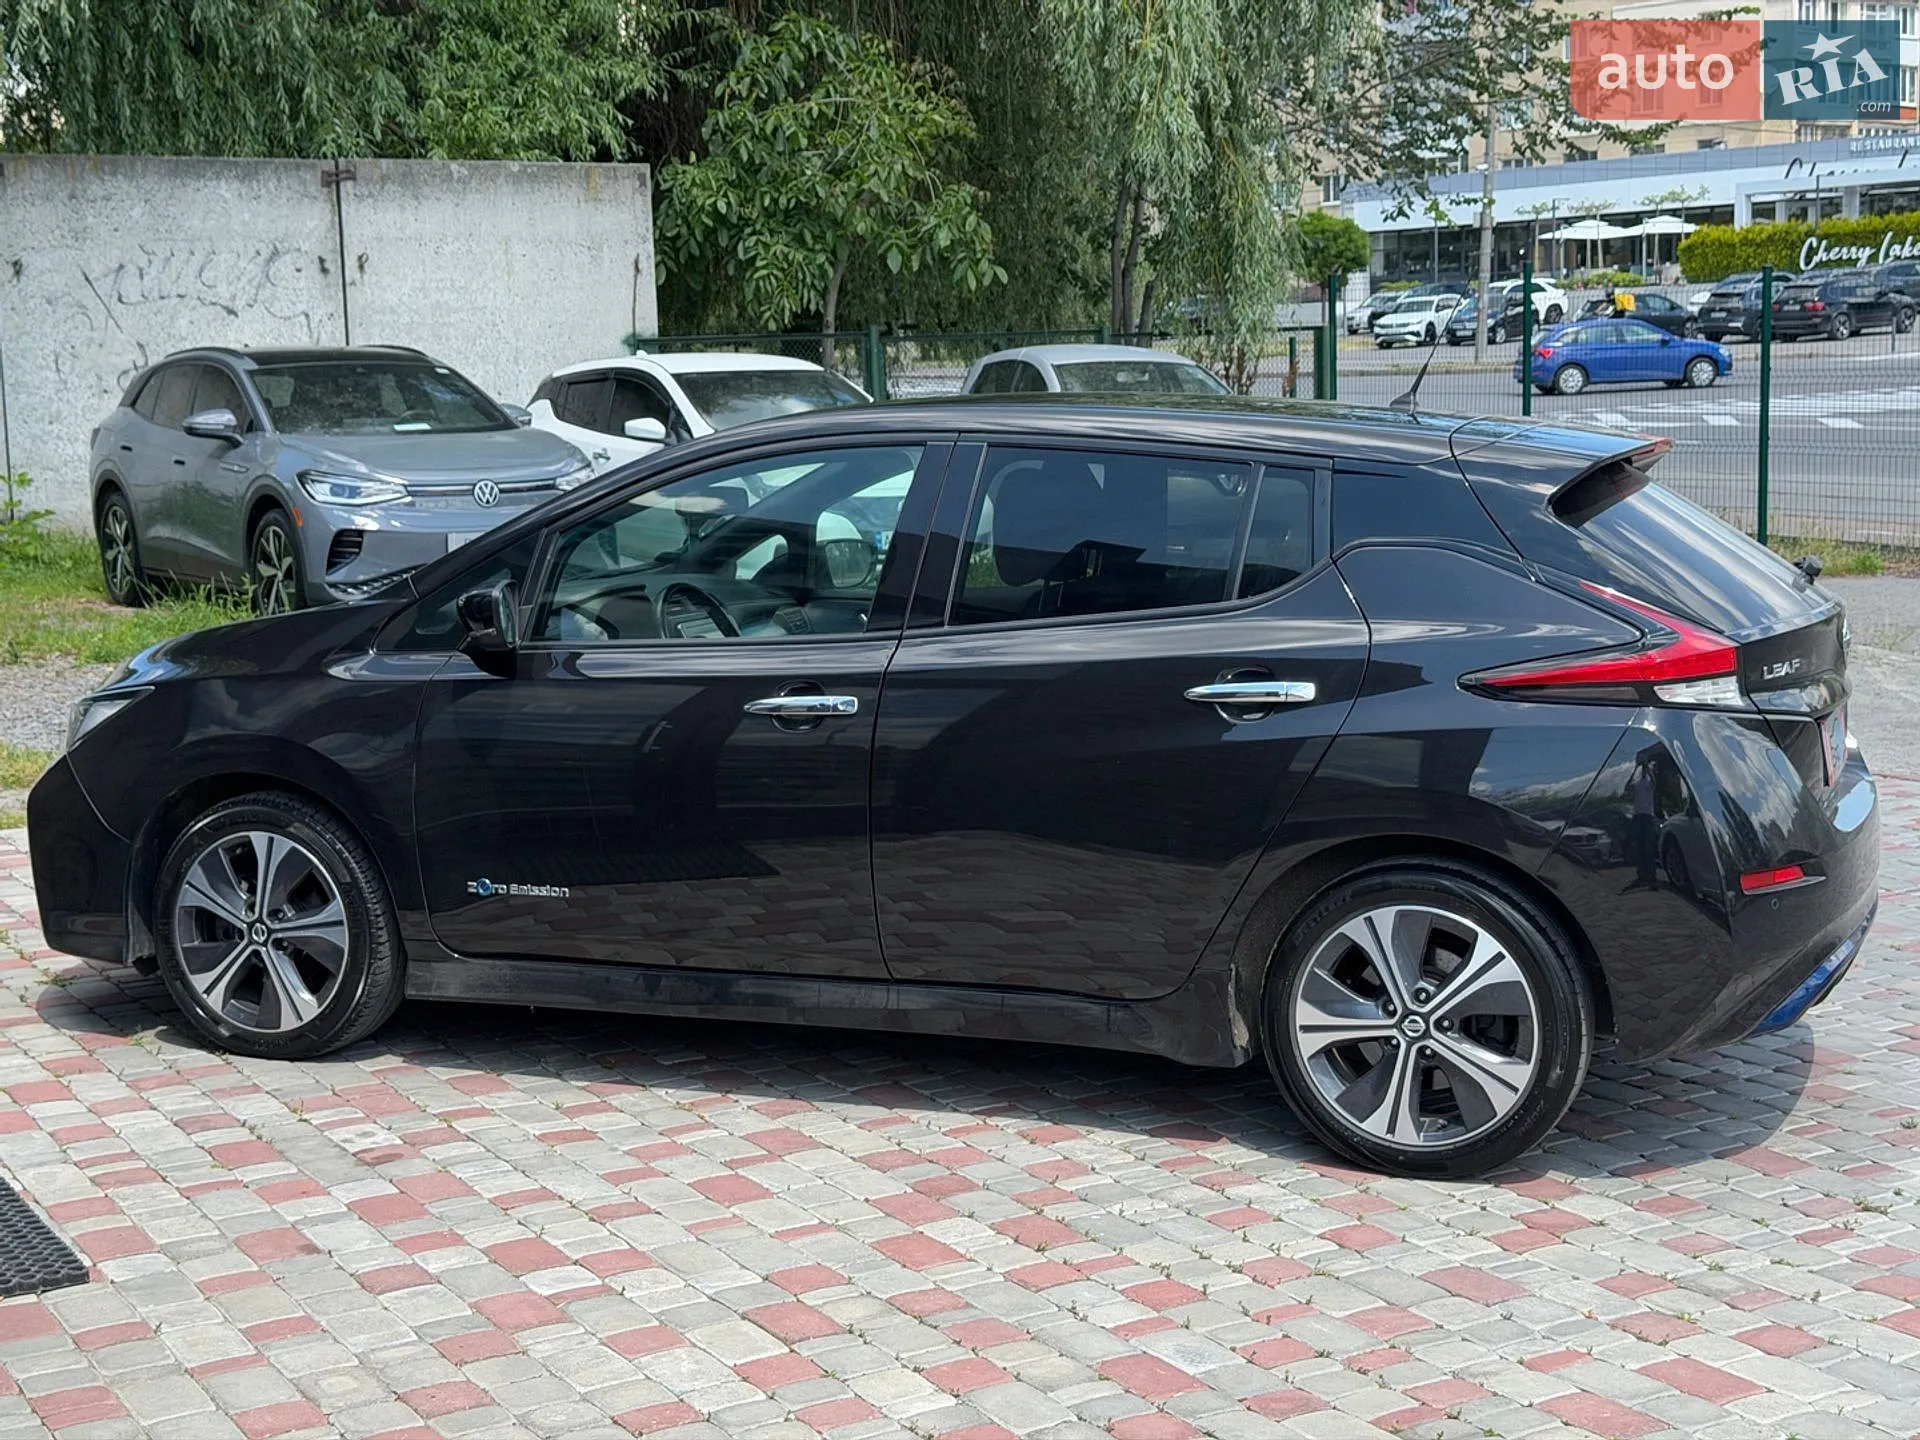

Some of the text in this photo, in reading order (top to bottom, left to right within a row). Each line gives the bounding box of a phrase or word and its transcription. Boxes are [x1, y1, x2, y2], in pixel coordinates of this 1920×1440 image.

[1800, 236, 1877, 271] Cherry
[1763, 658, 1801, 680] LEAF
[509, 883, 569, 898] Emission
